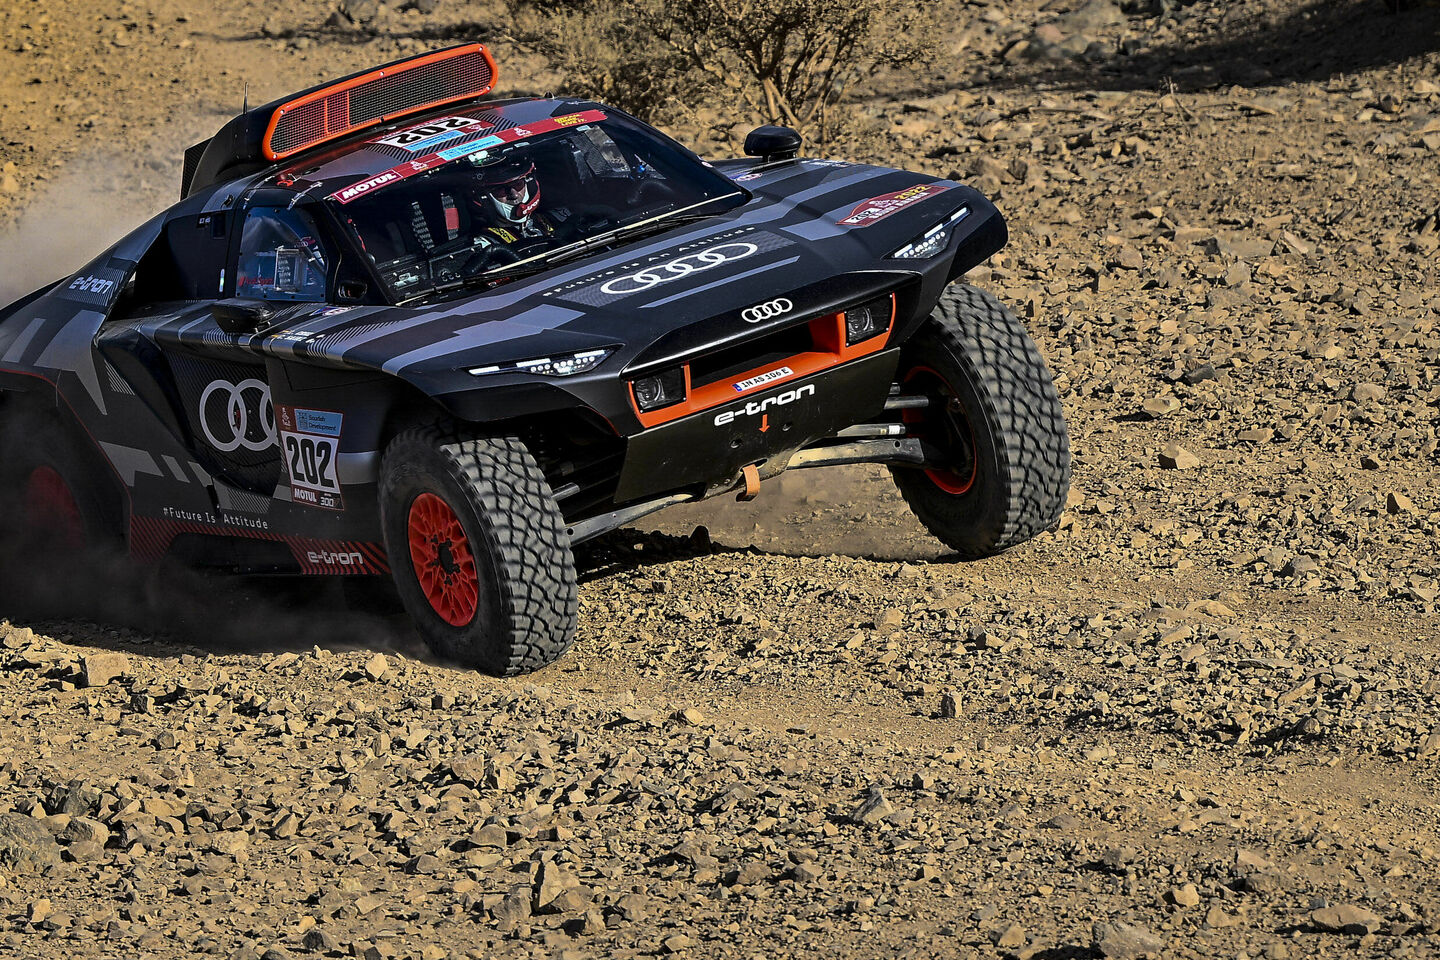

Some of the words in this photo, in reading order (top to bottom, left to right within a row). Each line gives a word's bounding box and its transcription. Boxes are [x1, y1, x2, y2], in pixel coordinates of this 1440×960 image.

[385, 119, 471, 144] 202
[342, 173, 397, 200] MOTUL
[894, 186, 932, 200] 2022
[679, 226, 756, 252] Attitude
[68, 274, 114, 294] e-tron
[714, 384, 815, 427] e-tron
[308, 422, 337, 431] Development
[286, 435, 335, 489] 202
[294, 487, 318, 503] MOTUL
[163, 507, 203, 522] #Future
[205, 512, 216, 524] Is
[223, 513, 269, 530] Attitude
[306, 549, 364, 565] e-tron
